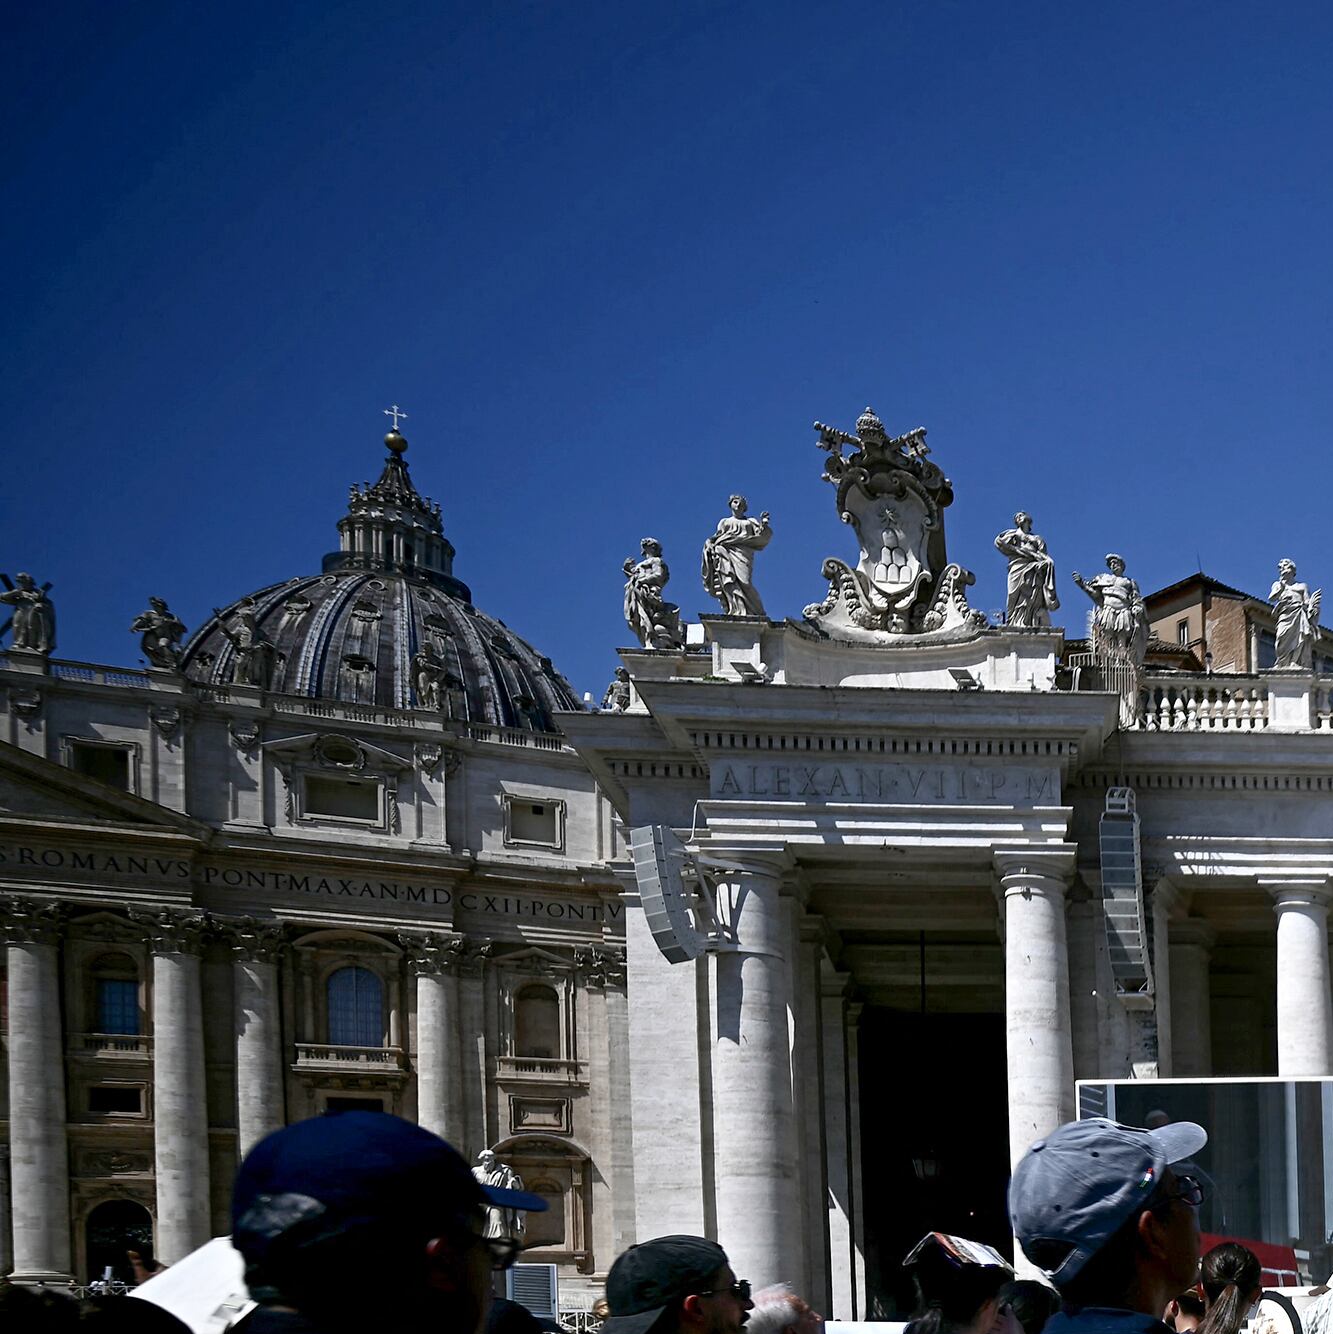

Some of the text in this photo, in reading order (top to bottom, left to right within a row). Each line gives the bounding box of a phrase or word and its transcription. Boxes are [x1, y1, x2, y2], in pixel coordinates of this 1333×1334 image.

[717, 765, 885, 797] ALEXAN
[907, 769, 967, 799] VII
[18, 847, 189, 878] ROMANVS
[531, 901, 602, 920] PONT
